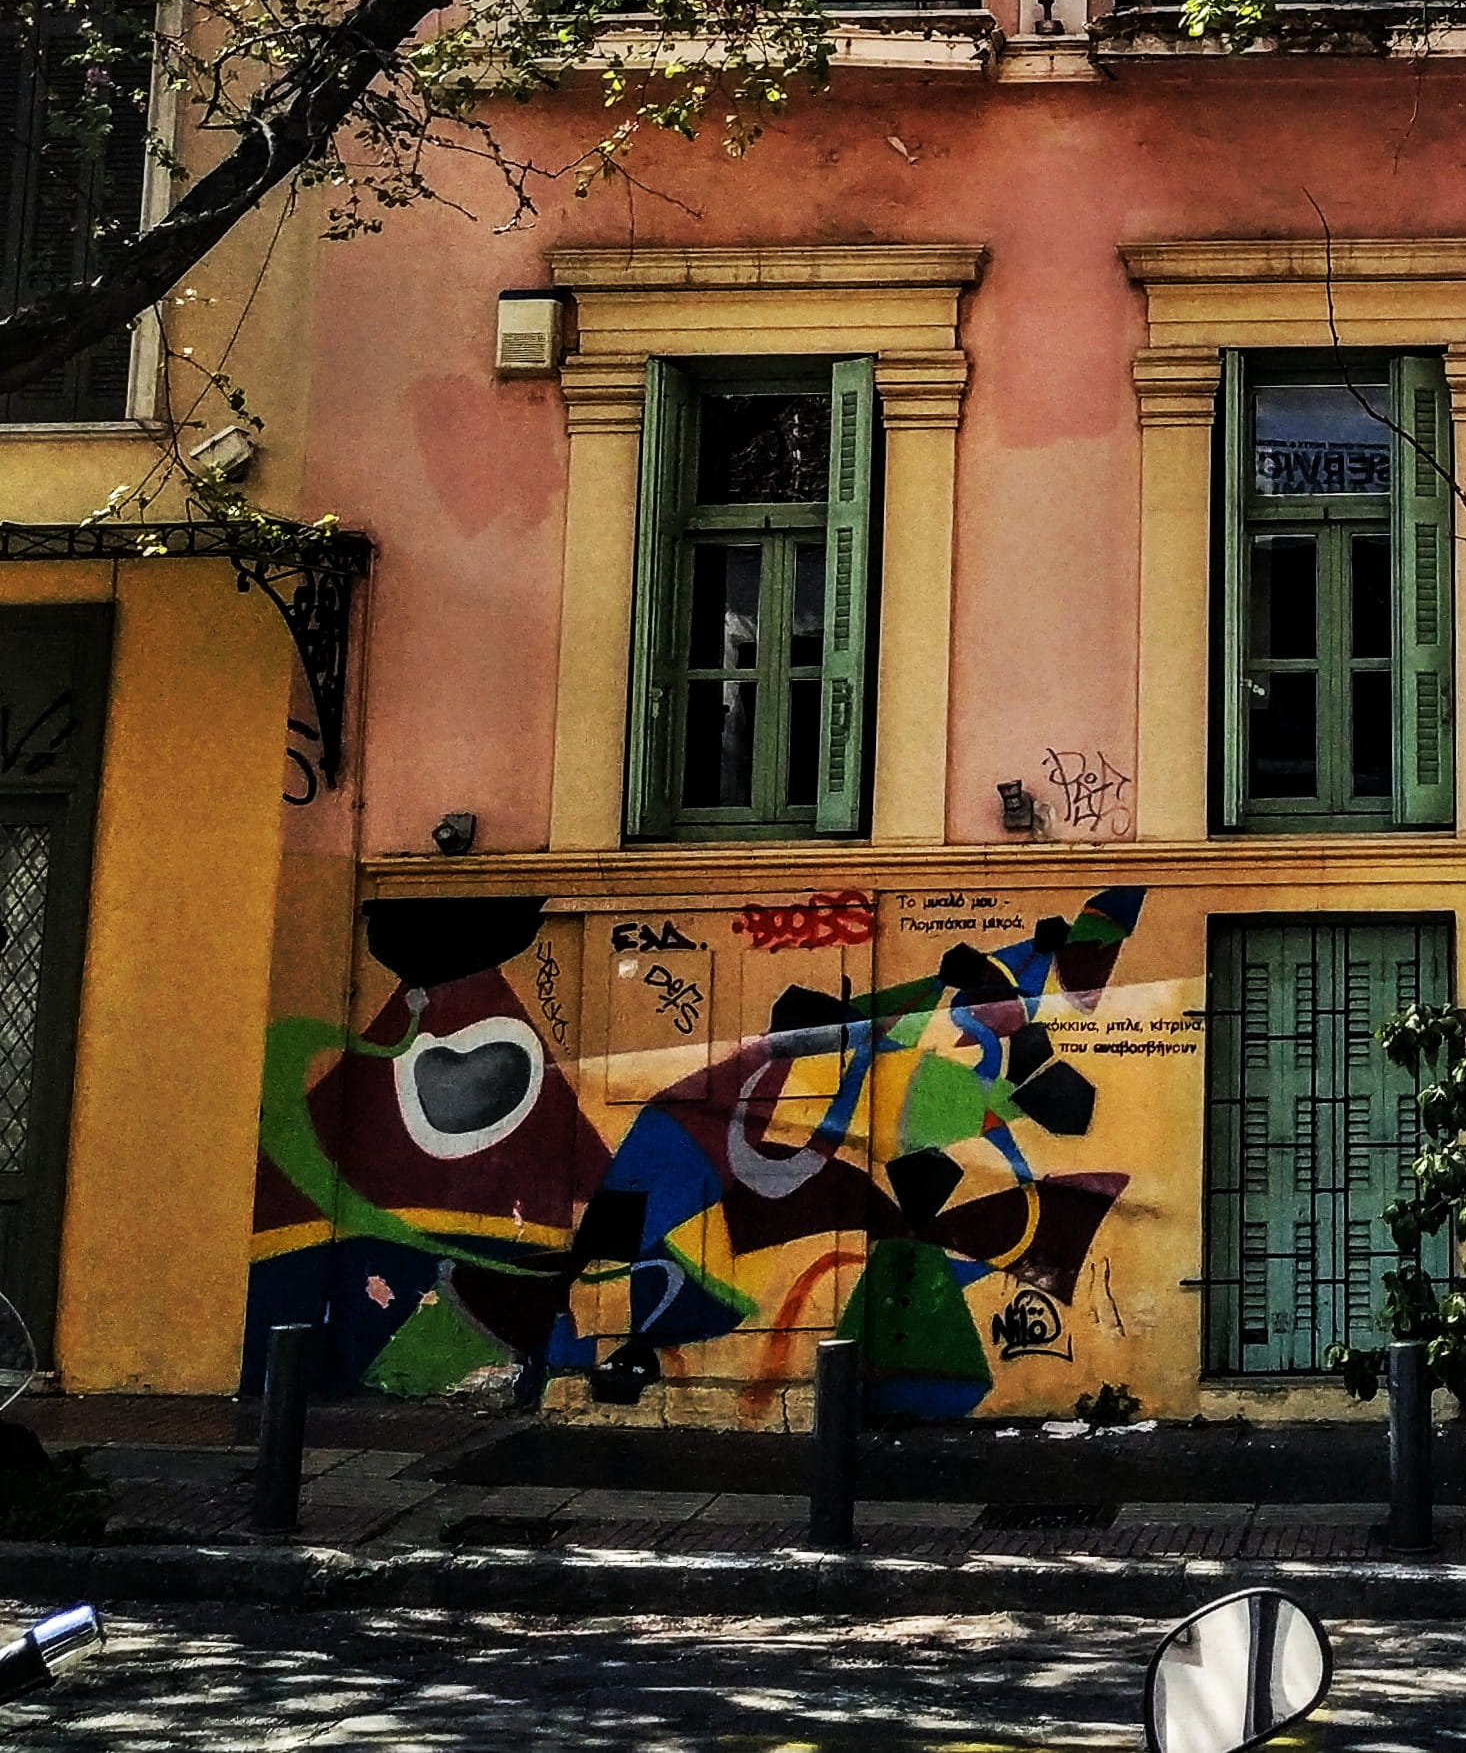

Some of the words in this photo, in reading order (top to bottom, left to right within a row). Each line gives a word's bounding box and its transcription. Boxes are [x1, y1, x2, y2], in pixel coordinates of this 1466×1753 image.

[896, 895, 916, 909] Το
[923, 893, 966, 910] μυαλό
[971, 896, 998, 910] μου
[900, 916, 977, 933] Γλομπάκια
[1043, 1018, 1100, 1033] κόκκινα,
[1106, 1018, 1143, 1034] μπλε,
[1150, 1019, 1205, 1034] κίτρινα,
[1060, 1043, 1088, 1054] που
[1093, 1040, 1198, 1057] αναβοσβήνουν
